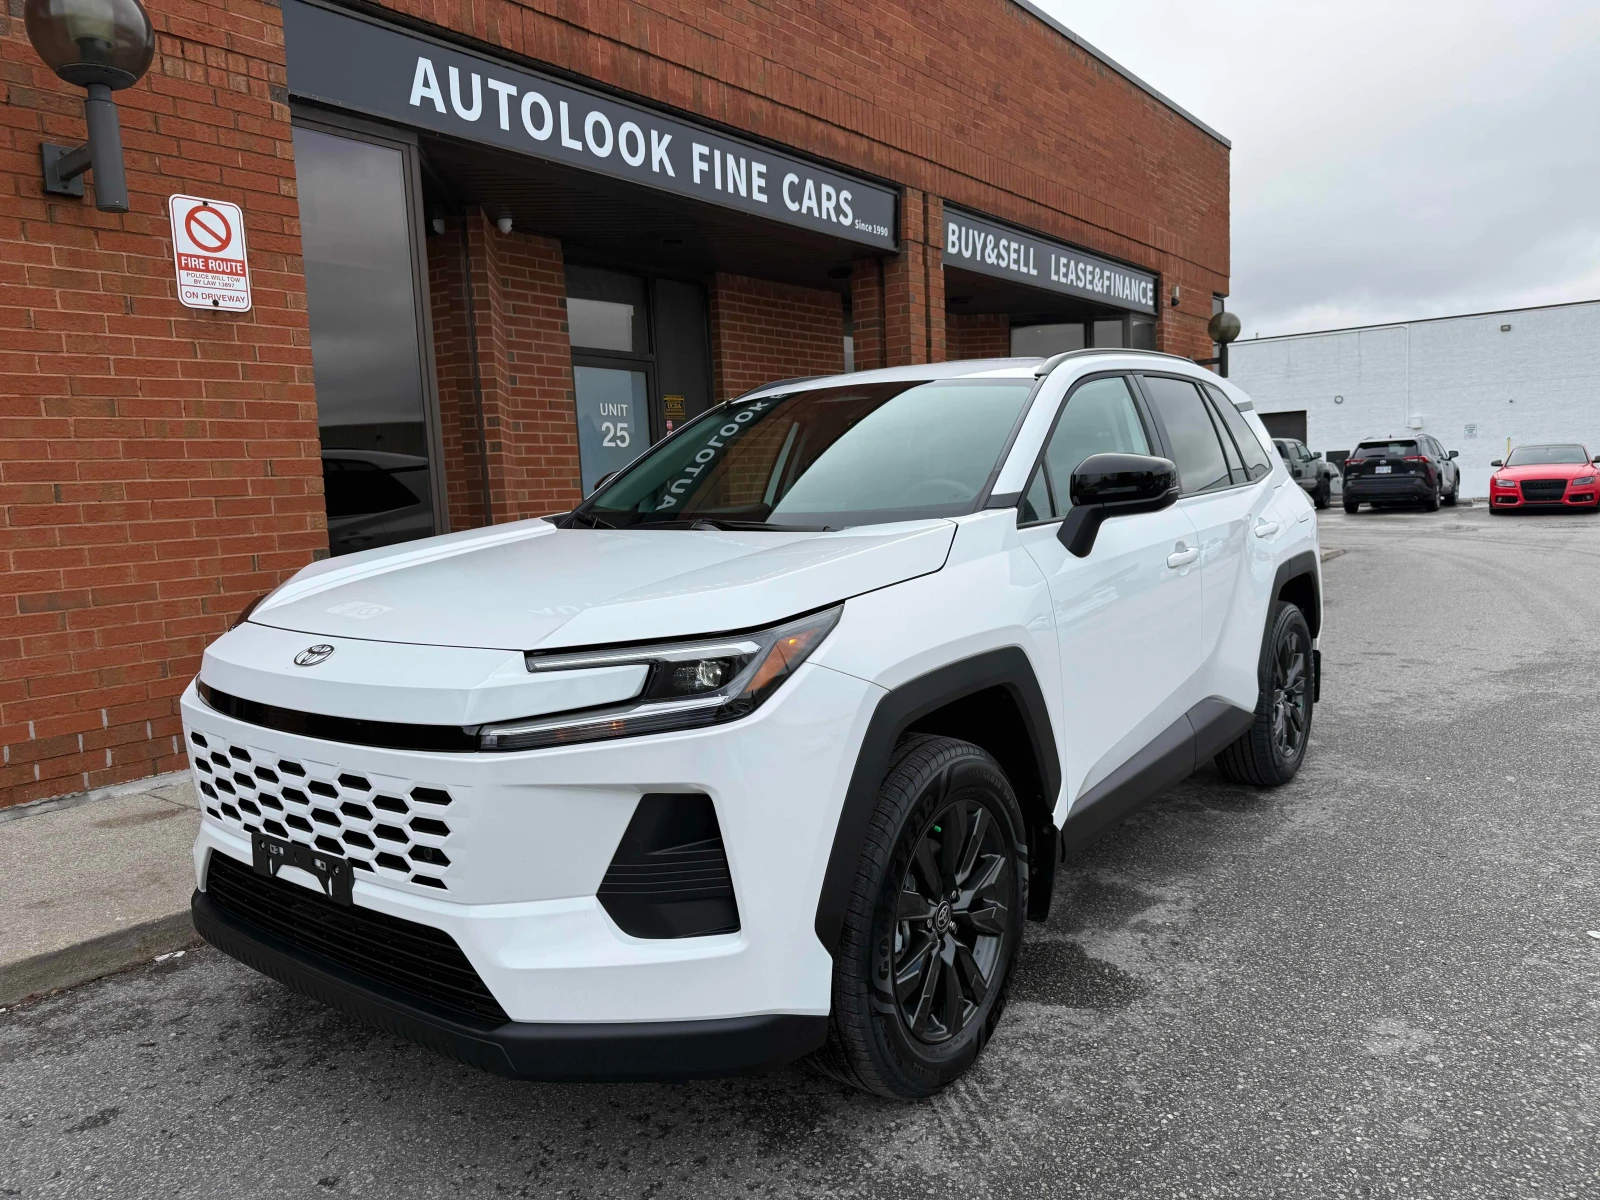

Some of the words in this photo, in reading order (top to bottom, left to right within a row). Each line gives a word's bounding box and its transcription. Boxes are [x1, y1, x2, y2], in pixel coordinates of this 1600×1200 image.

[409, 56, 676, 177] AUTOLOOK
[692, 142, 768, 203] FINE
[782, 172, 853, 226] CARS
[855, 219, 873, 233] Since
[873, 224, 888, 237] 1990
[181, 256, 205, 269] FIRE
[208, 259, 243, 273] ROUTE
[947, 222, 1038, 276] BUY&SELL
[1051, 254, 1154, 306] LEASE&FINANCE
[185, 291, 198, 299] ON
[201, 292, 245, 303] DRIVEWAY
[600, 402, 628, 417] UNIT
[601, 421, 630, 448] 25
